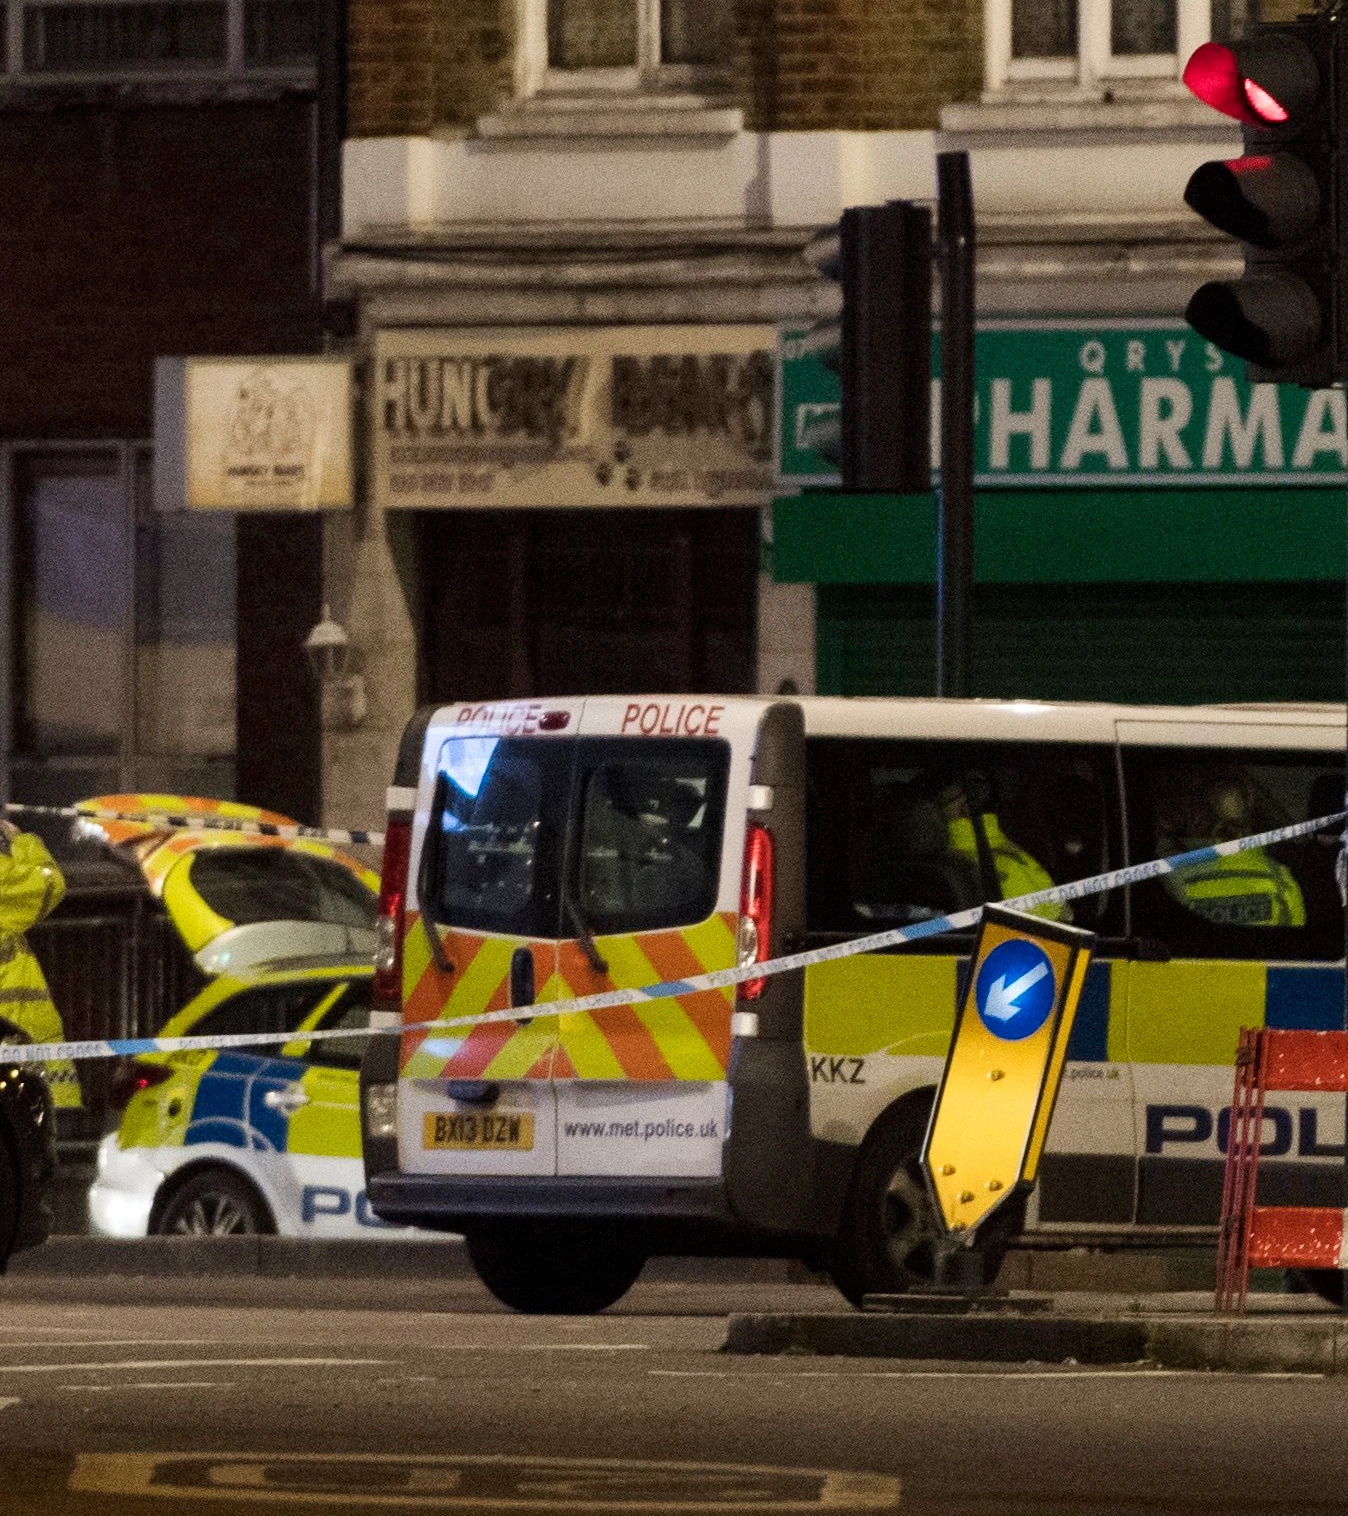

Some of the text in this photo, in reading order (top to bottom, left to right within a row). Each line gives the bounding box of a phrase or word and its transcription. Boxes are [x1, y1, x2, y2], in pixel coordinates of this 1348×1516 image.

[1079, 340, 1224, 373] QRYS
[621, 703, 725, 736] POLICE
[810, 1056, 866, 1083] KKZ
[434, 1114, 477, 1143] BX13
[564, 1118, 718, 1141] www.met.police.uk
